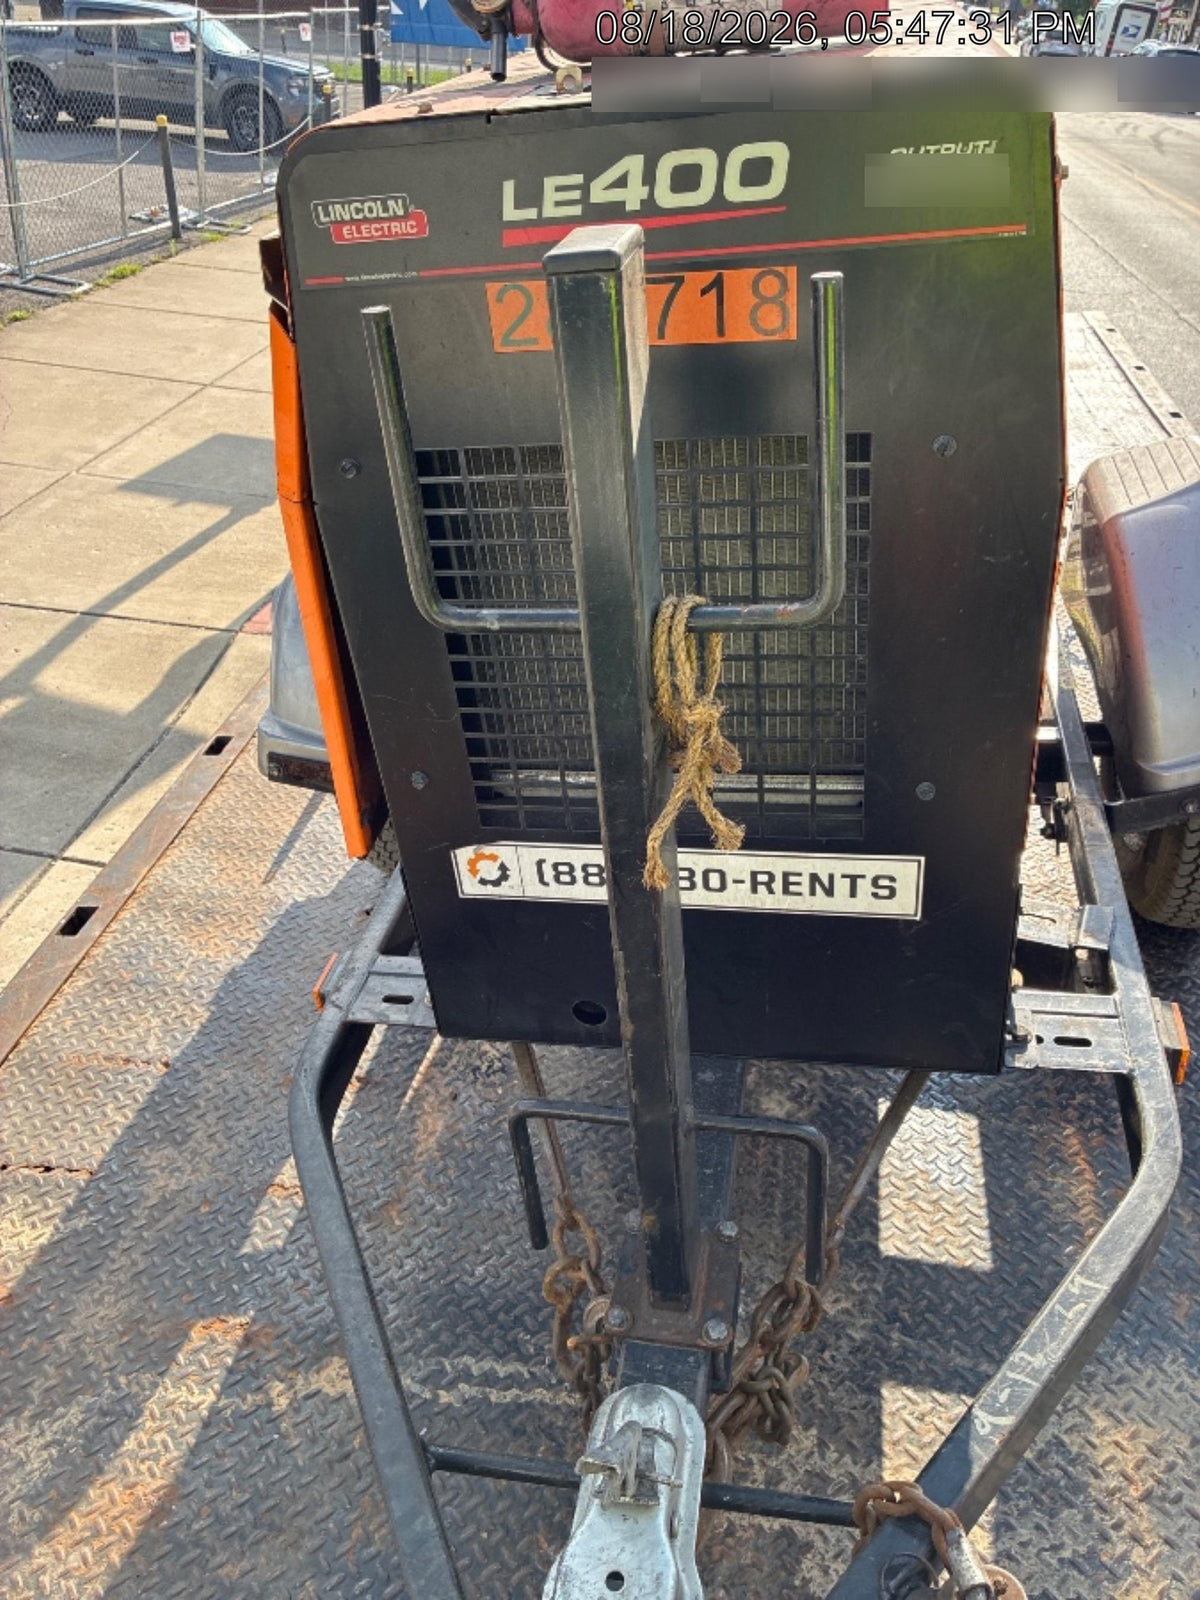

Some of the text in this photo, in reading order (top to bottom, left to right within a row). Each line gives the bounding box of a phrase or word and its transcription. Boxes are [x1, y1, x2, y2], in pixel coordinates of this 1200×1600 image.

[502, 140, 791, 222] LE400
[317, 198, 406, 222] LINCOLN
[342, 220, 418, 239] ELECTRIC
[496, 267, 790, 347] 2718
